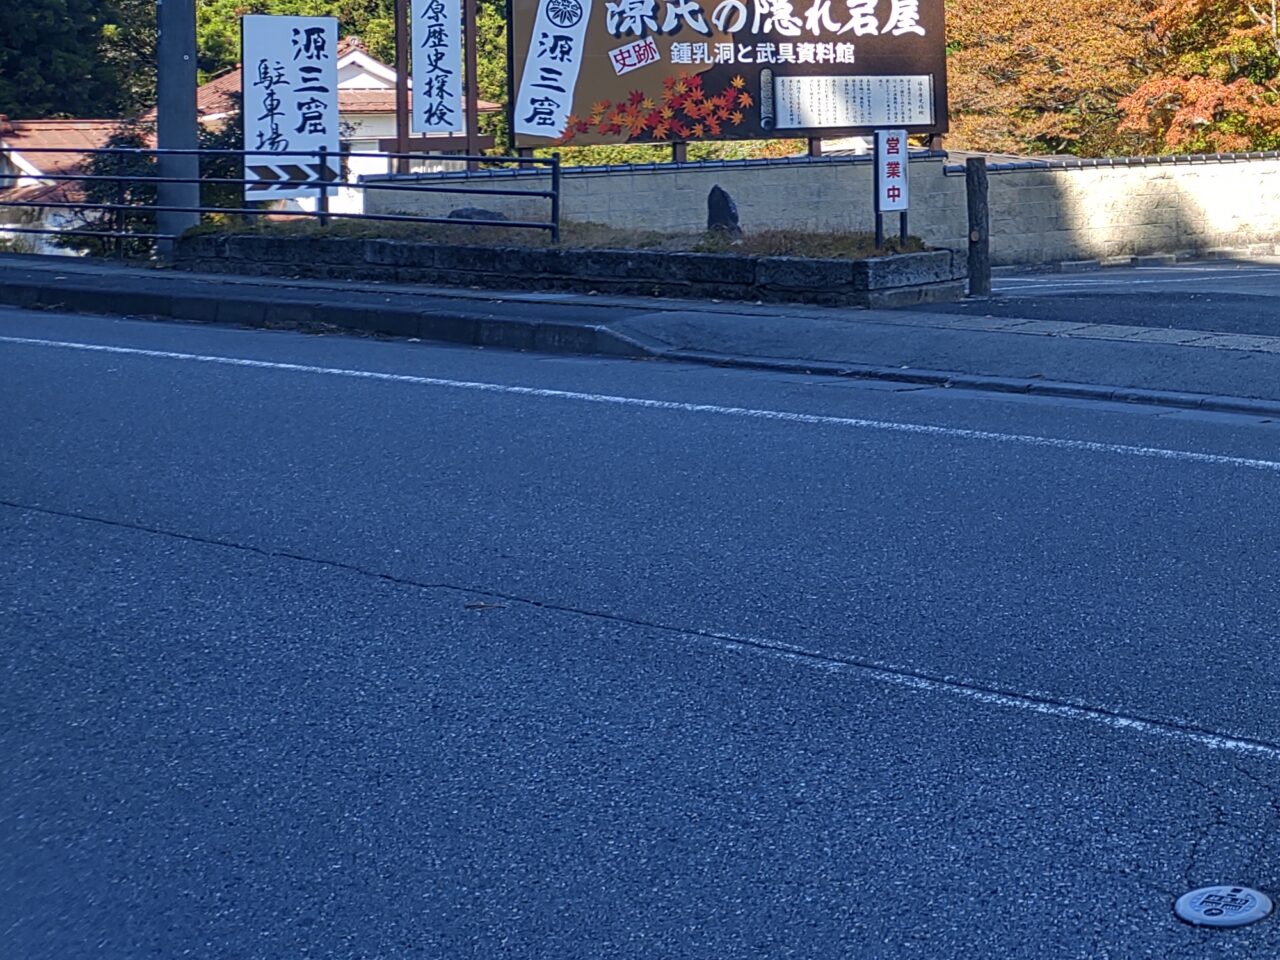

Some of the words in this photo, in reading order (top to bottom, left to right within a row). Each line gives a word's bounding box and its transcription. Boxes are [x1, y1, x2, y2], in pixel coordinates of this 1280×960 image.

[292, 27, 330, 135] 源三窟
[523, 32, 575, 127] 源三窟
[613, 40, 657, 73] 史跡
[253, 59, 290, 151] 駐車場
[886, 136, 901, 203] 営業中
